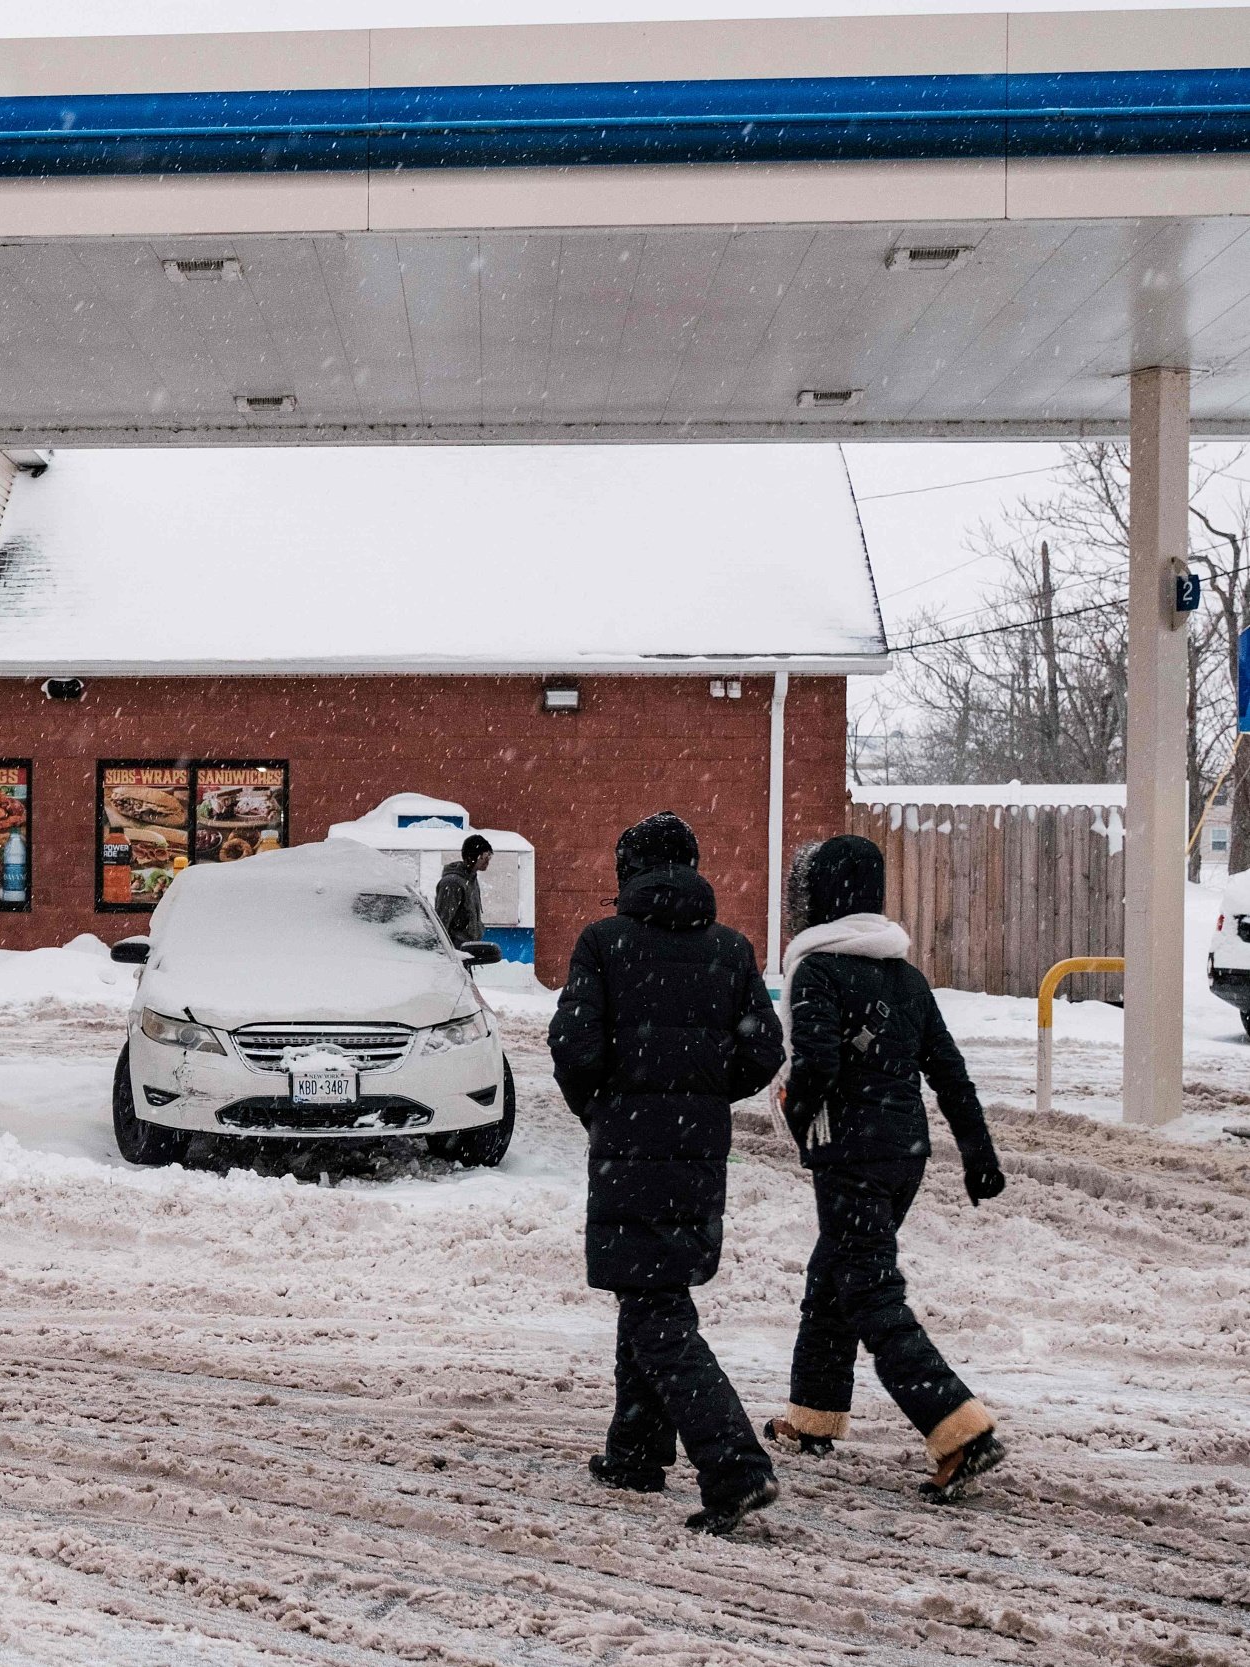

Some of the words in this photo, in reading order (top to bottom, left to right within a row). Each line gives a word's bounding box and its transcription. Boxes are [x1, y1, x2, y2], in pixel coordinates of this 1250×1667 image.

[1182, 581, 1193, 601] 2
[106, 769, 187, 785] SUBS-WRAPS
[197, 769, 281, 785] SANDWICHES
